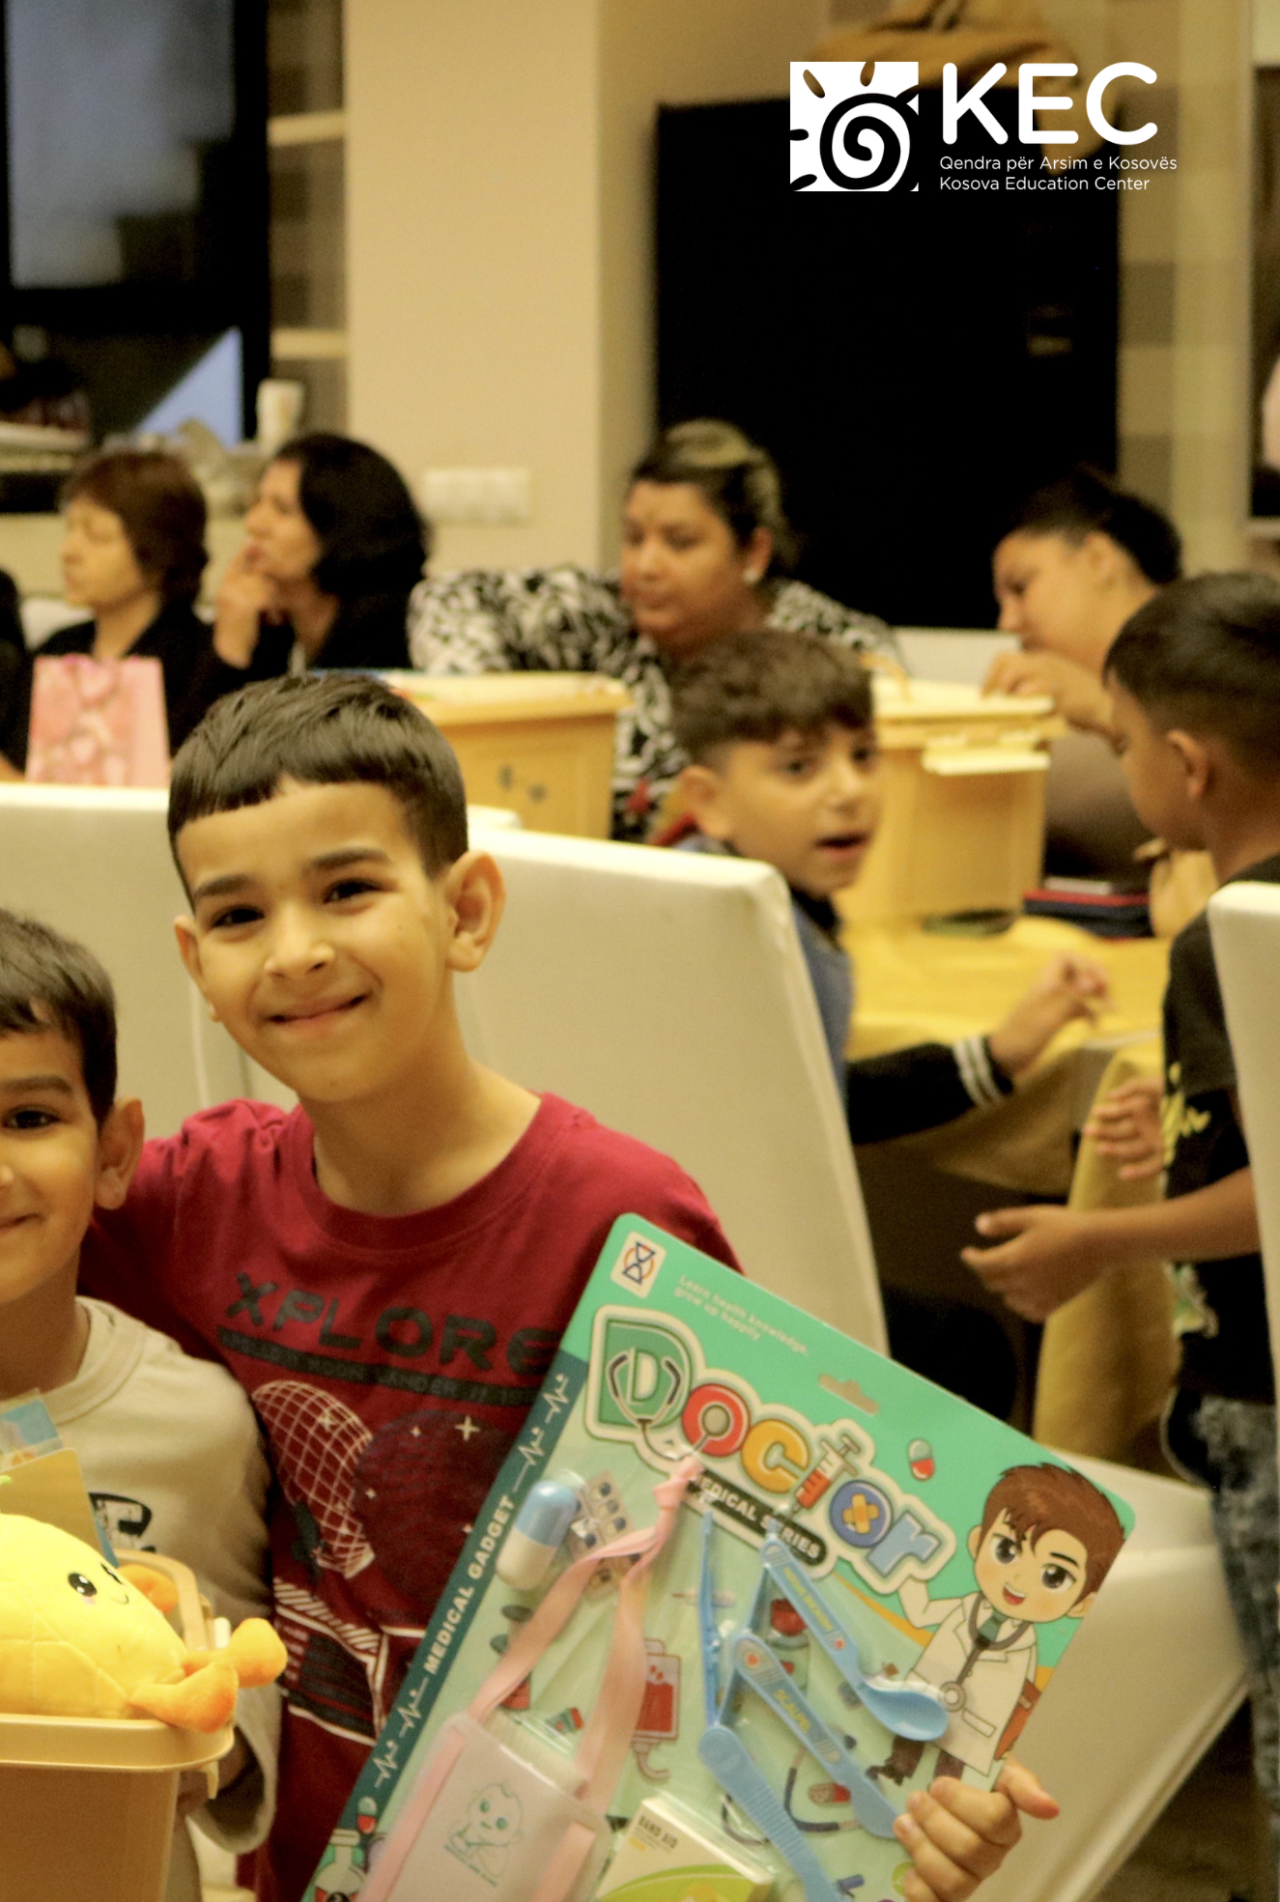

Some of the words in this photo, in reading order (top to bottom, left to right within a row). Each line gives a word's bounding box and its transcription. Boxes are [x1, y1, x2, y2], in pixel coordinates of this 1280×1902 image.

[225, 1271, 561, 1376] XPLORE
[673, 1286, 702, 1306] grow
[703, 1302, 719, 1317] up
[720, 1310, 762, 1342] happily
[679, 1274, 711, 1299] Learn
[712, 1293, 747, 1318] health
[760, 1514, 821, 1559] SRIES
[423, 1586, 475, 1675] MEDICAL
[467, 1494, 516, 1580] GADGET
